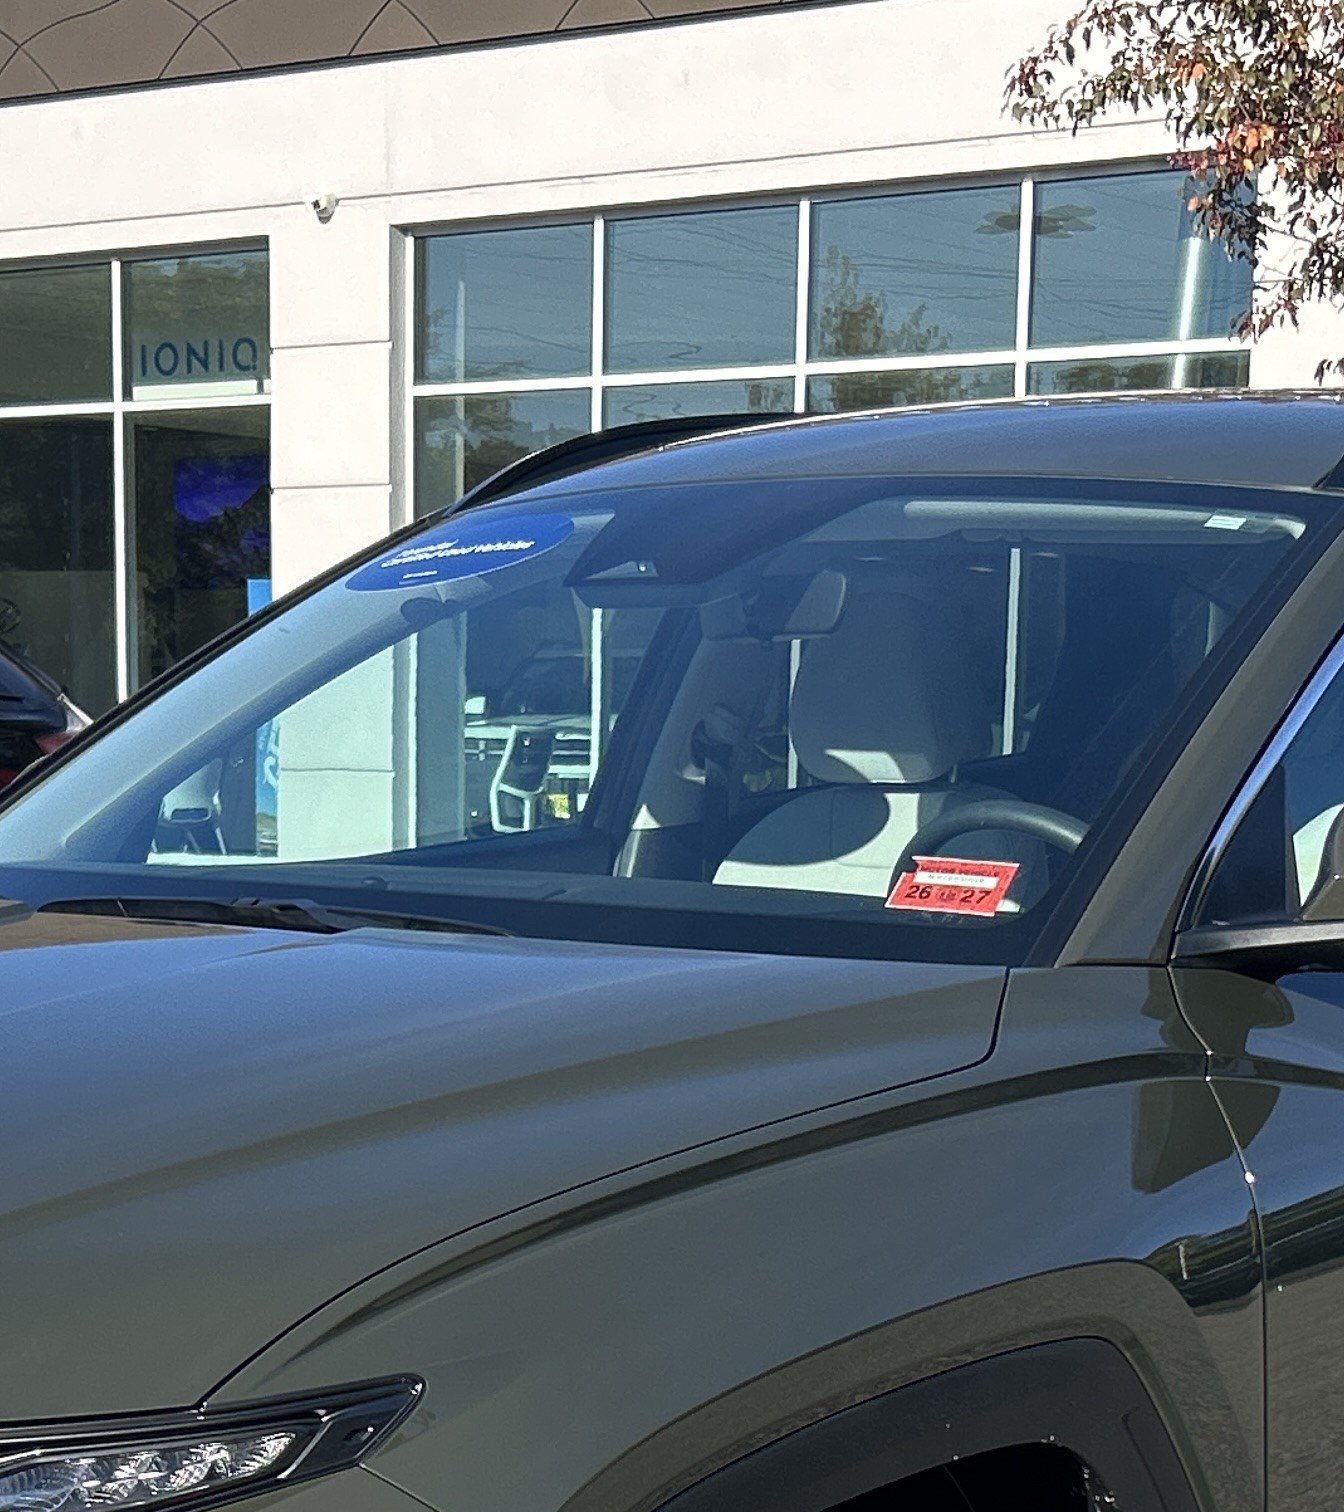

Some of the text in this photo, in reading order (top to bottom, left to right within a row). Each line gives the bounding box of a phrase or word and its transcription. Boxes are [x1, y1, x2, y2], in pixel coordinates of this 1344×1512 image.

[139, 336, 258, 377] IONIQ
[904, 885, 933, 899] 26
[959, 889, 992, 904] 27
